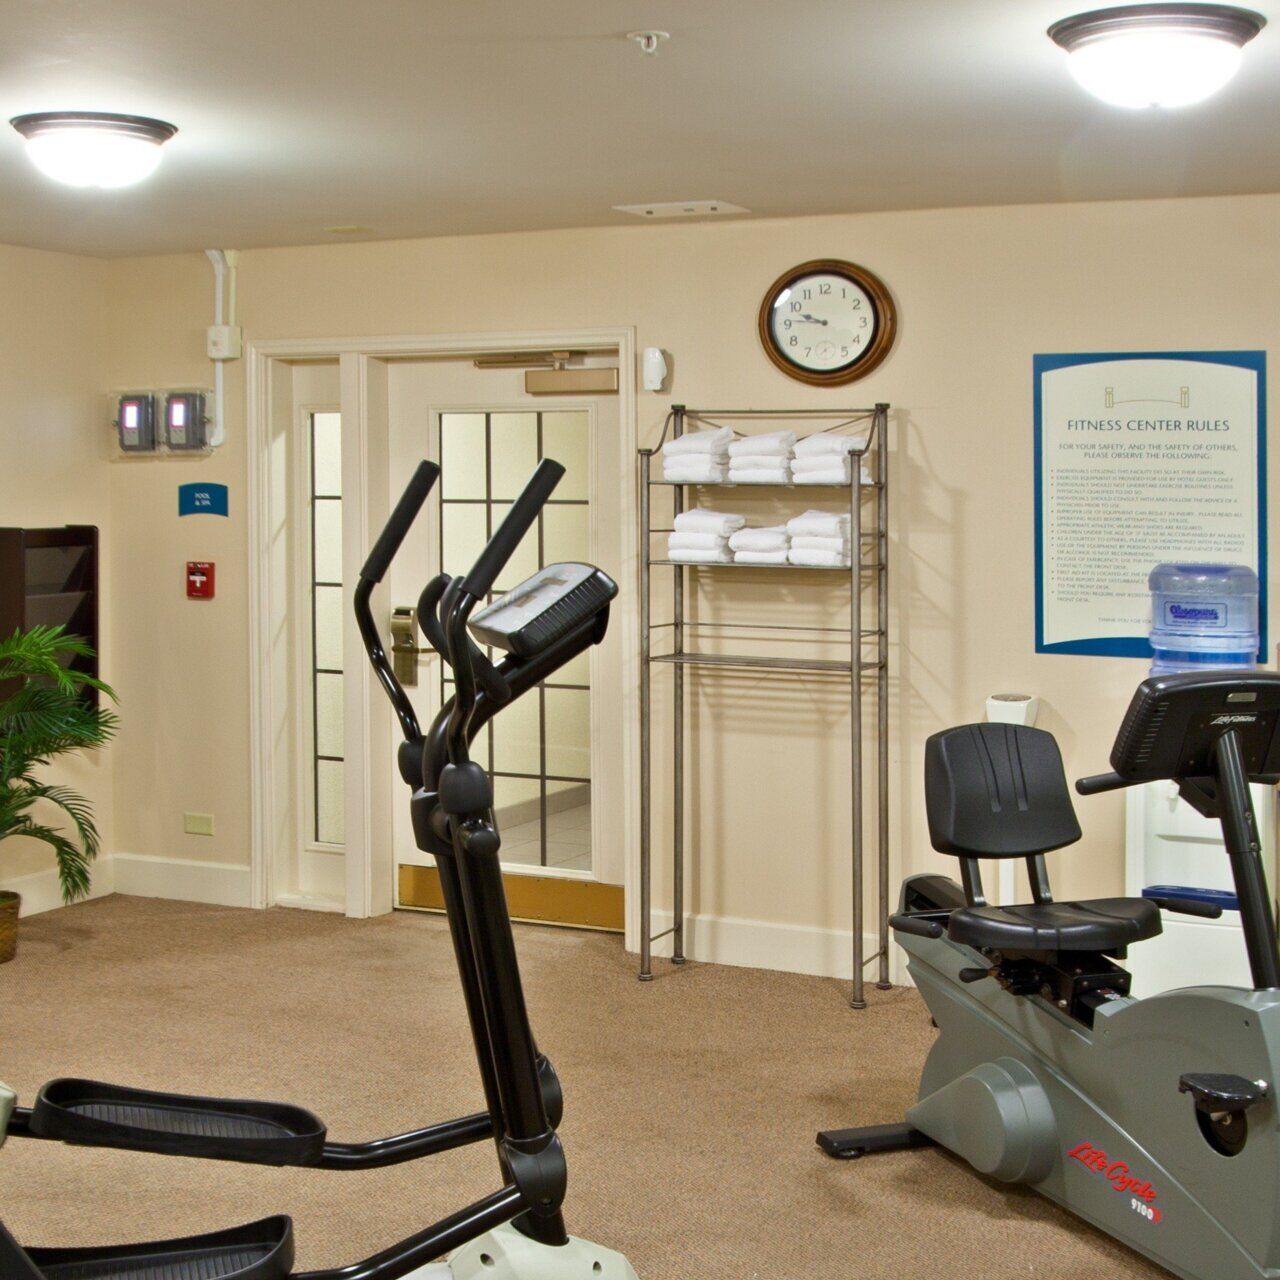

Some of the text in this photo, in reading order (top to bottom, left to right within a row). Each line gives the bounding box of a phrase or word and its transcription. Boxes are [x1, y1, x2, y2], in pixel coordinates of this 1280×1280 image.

[803, 289, 812, 300] 11
[819, 284, 831, 295] 12
[841, 288, 846, 298] 1
[790, 301, 802, 312] 10
[852, 299, 861, 310] 2
[784, 319, 792, 330] 9
[859, 317, 867, 327] 3
[789, 336, 798, 346] 8
[852, 334, 860, 345] 4
[804, 347, 812, 358] 7
[841, 346, 849, 357] 5
[1067, 419, 1230, 432] FITNESS CENTER RULES
[1074, 443, 1096, 451] YOUR
[1098, 443, 1126, 451] SAFETY,
[1128, 443, 1146, 451] AND
[1148, 443, 1162, 451] THE
[1164, 443, 1190, 451] SAFETY
[1131, 1198, 1154, 1220] 9100
